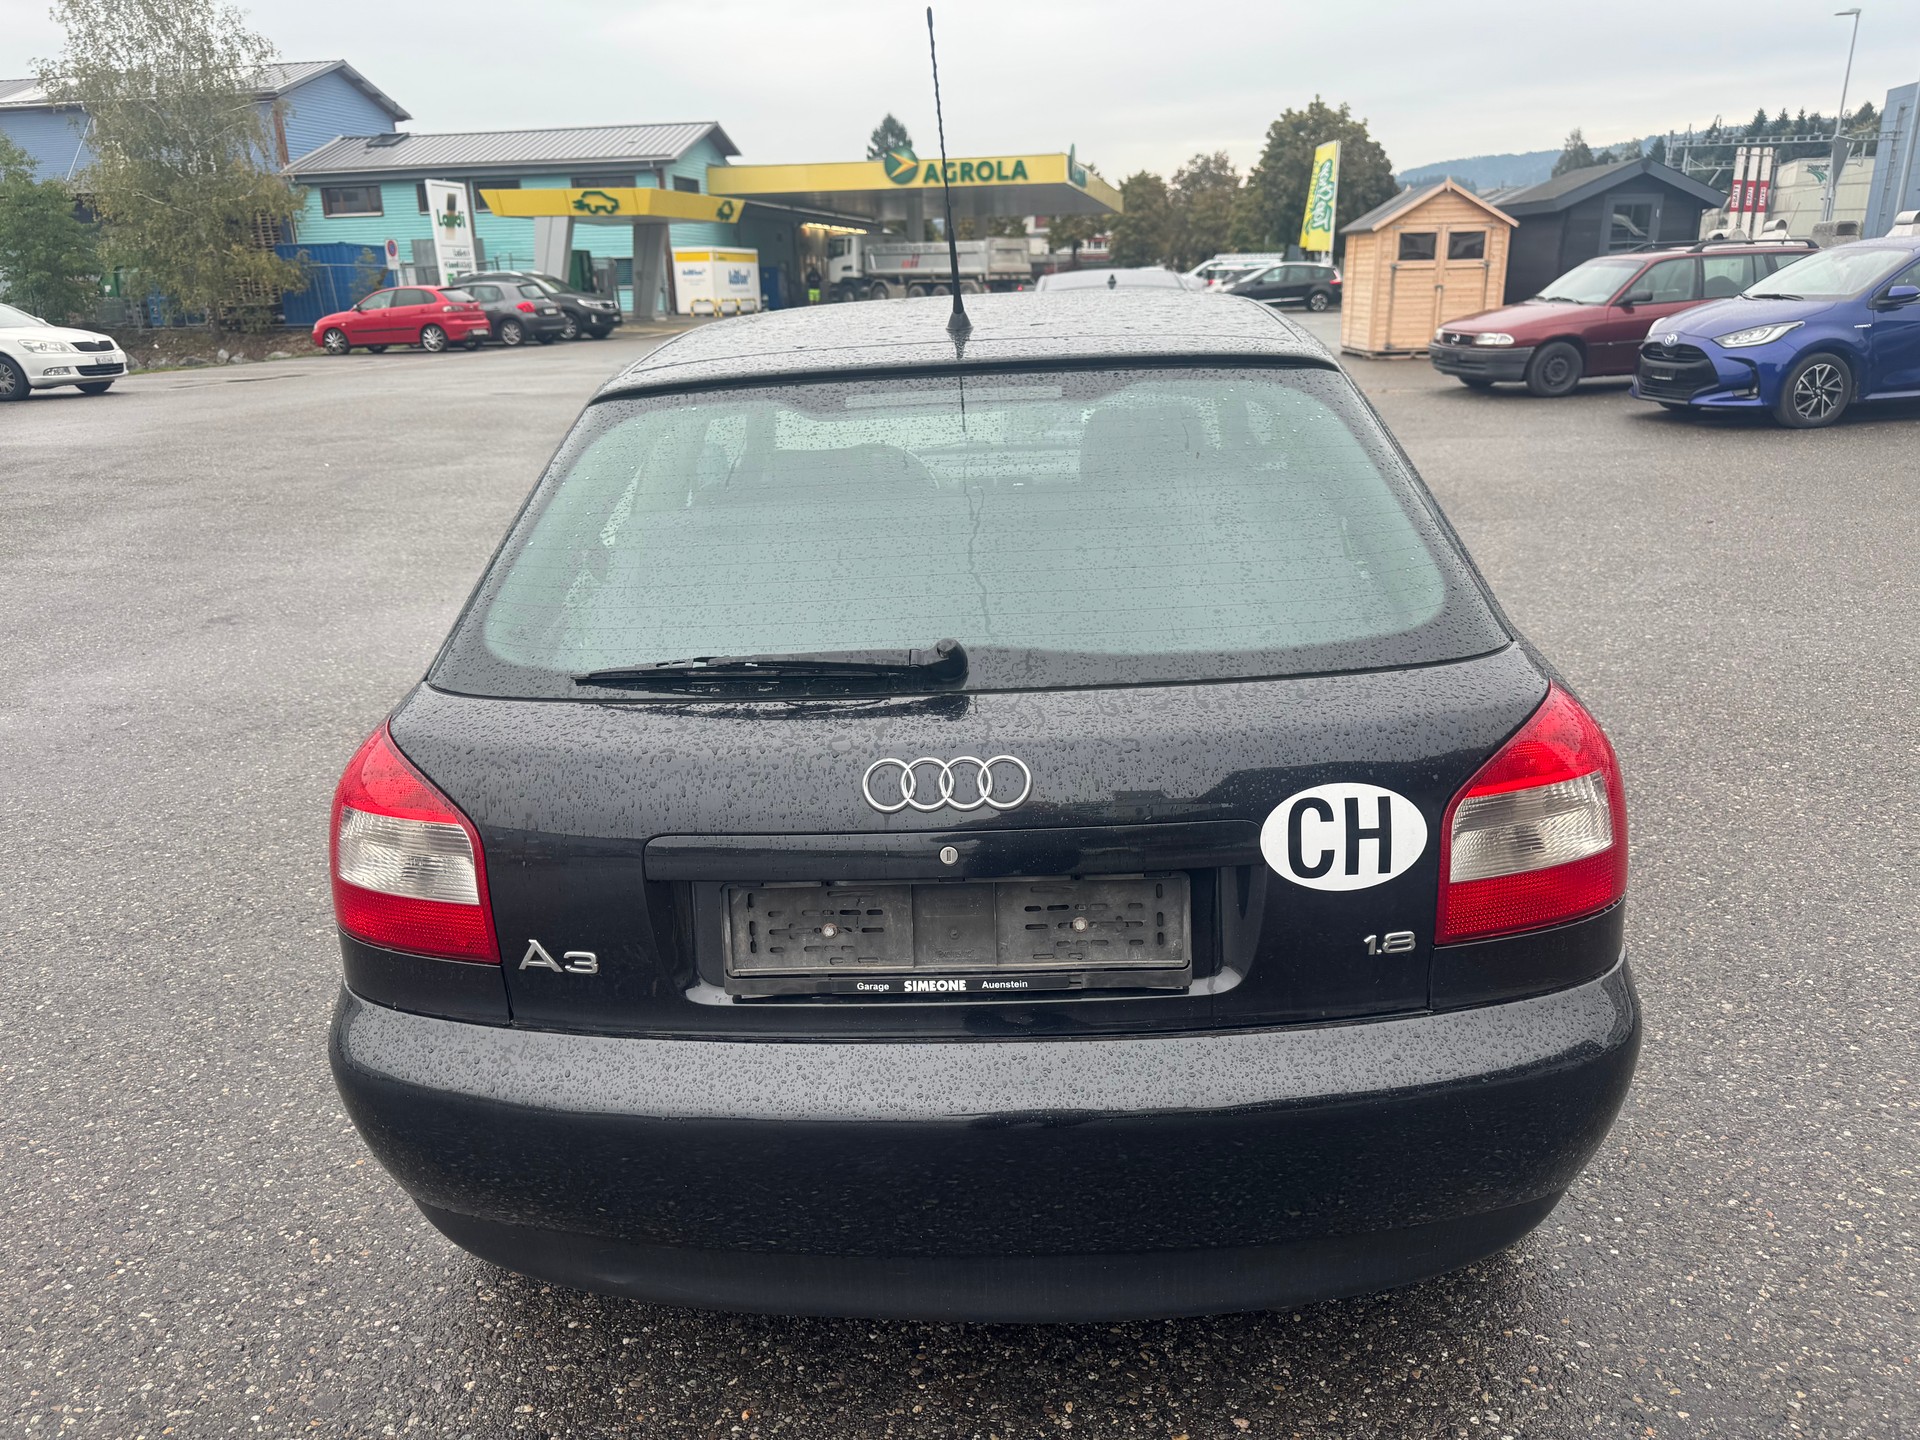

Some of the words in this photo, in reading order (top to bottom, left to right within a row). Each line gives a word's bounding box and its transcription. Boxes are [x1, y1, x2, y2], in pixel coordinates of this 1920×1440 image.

[923, 160, 1028, 183] AGROLA
[1288, 796, 1392, 878] CH
[1363, 931, 1416, 955] 1.8
[518, 938, 599, 974] A3
[856, 982, 890, 992] Garage
[903, 979, 967, 992] SIMEONE
[981, 980, 1028, 990] Auenstein
